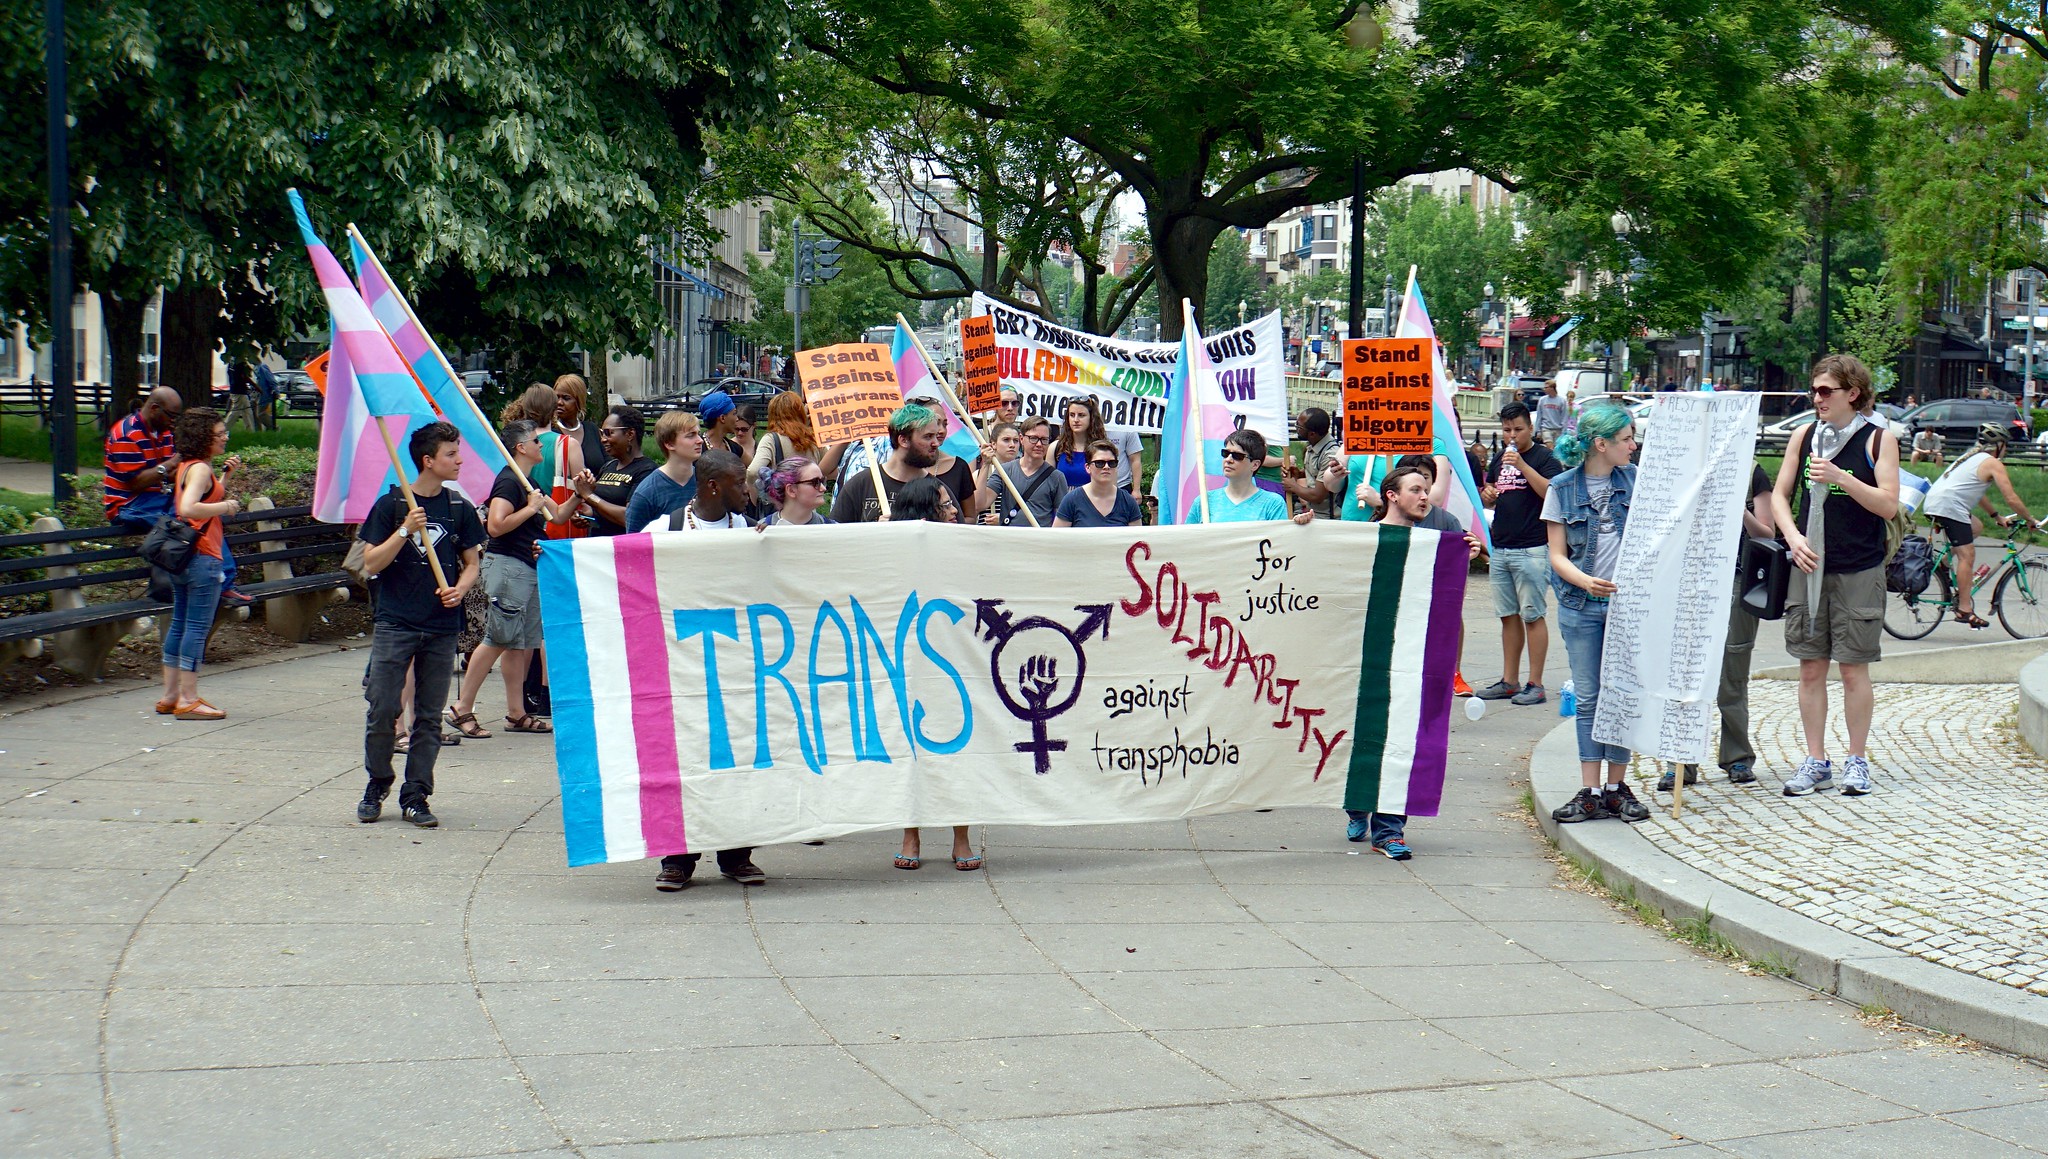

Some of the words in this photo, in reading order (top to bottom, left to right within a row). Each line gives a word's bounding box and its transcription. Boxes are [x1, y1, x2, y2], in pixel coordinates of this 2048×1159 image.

[965, 320, 990, 338] Stand
[811, 348, 880, 368] Stand
[964, 343, 996, 362] against
[1355, 344, 1420, 363] Stand
[808, 368, 895, 390] against
[967, 366, 997, 380] anti-trans
[1346, 372, 1430, 392] against
[968, 381, 998, 398] bigotry
[812, 392, 900, 409] anti-trans
[1348, 398, 1430, 411] anti-trans
[1668, 396, 1697, 412] REST
[1704, 399, 1721, 413] IN
[1350, 414, 1428, 436] bigotry
[820, 428, 850, 442] PSL
[1348, 438, 1374, 450] PSL
[1378, 443, 1430, 452] PSLweb.org
[1252, 538, 1296, 580] for
[1240, 583, 1320, 622] justice
[673, 590, 973, 776] TRANS
[1120, 540, 1348, 782] SOLIDARITY
[1103, 675, 1194, 718] against
[1091, 727, 1240, 788] transphobia
